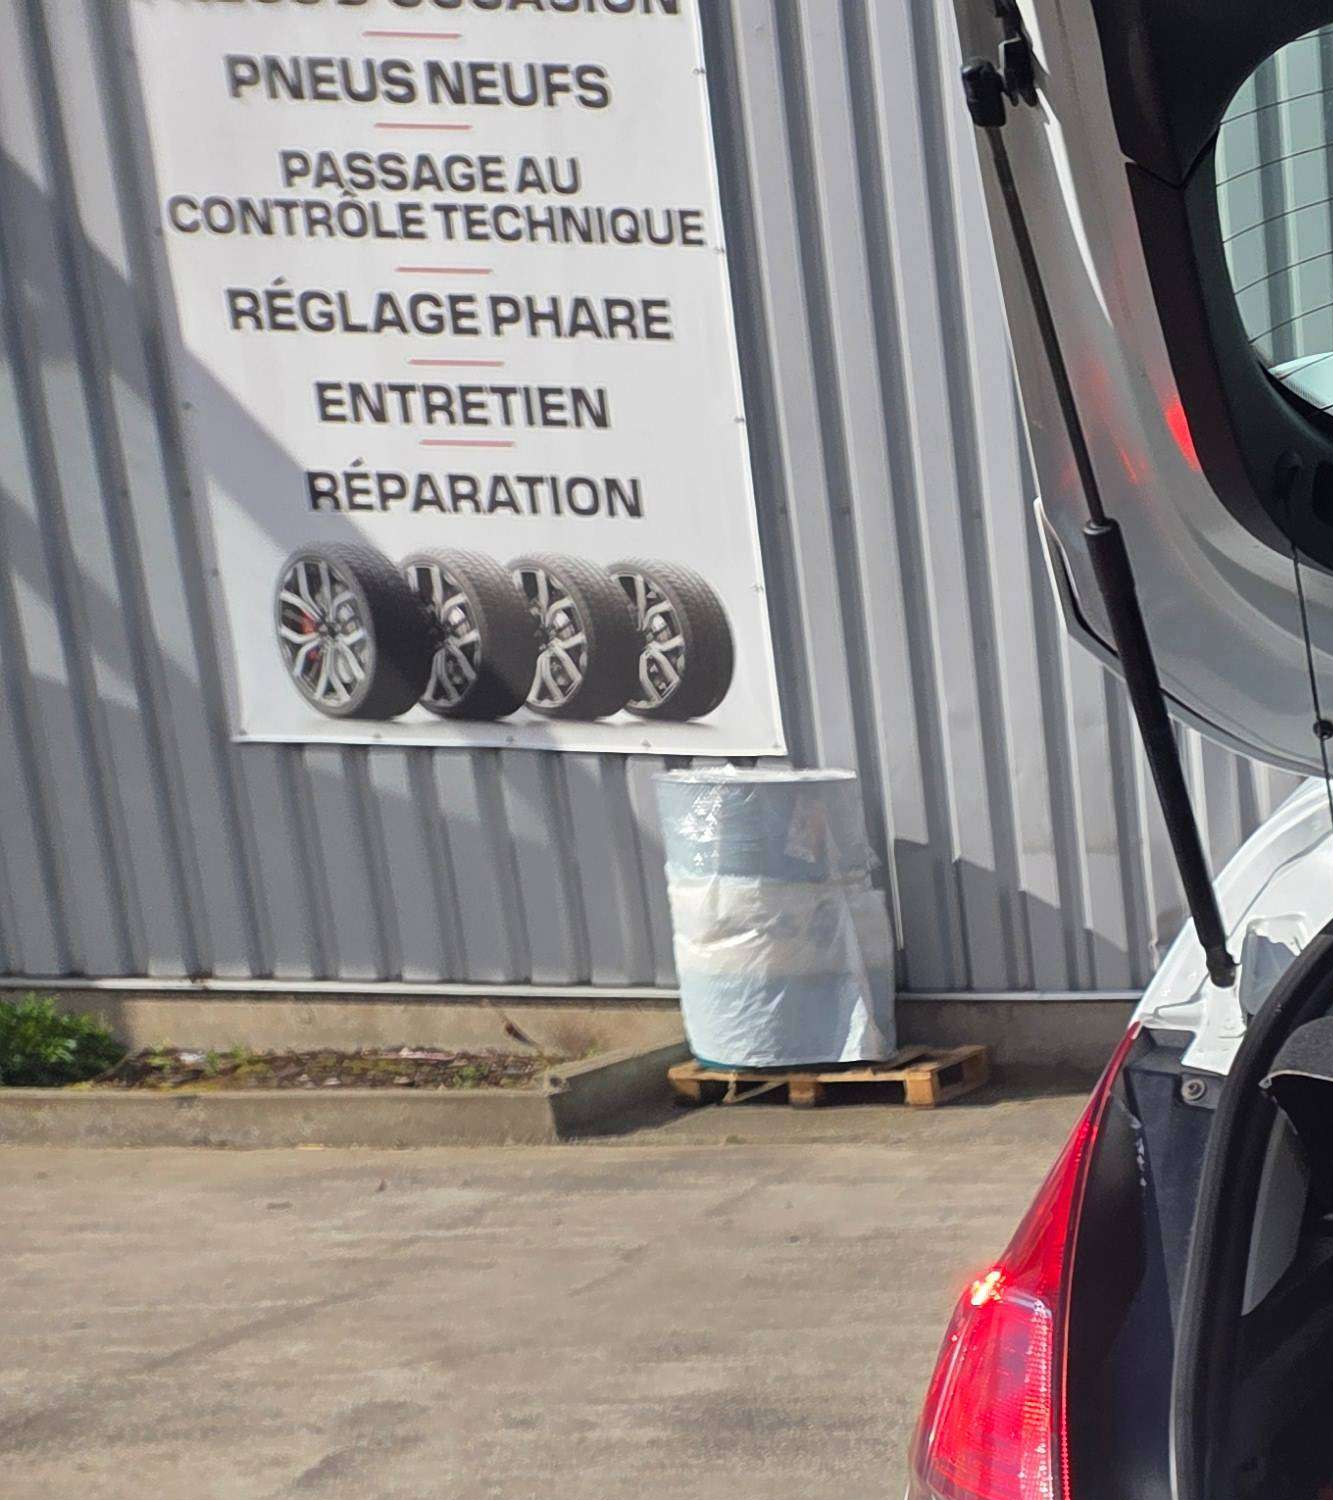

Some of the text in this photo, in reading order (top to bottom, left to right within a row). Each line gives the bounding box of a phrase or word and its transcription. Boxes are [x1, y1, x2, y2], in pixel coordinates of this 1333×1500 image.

[223, 53, 611, 109] PNEUS NEUFS
[280, 150, 583, 195] PASSAGE AU
[167, 188, 708, 247] CONTRÔLE TECHNIQUE
[226, 277, 674, 341] RÉGLAGE PHARE
[314, 380, 611, 429] ENTRETIEN
[305, 457, 645, 518] RÉPARATION
